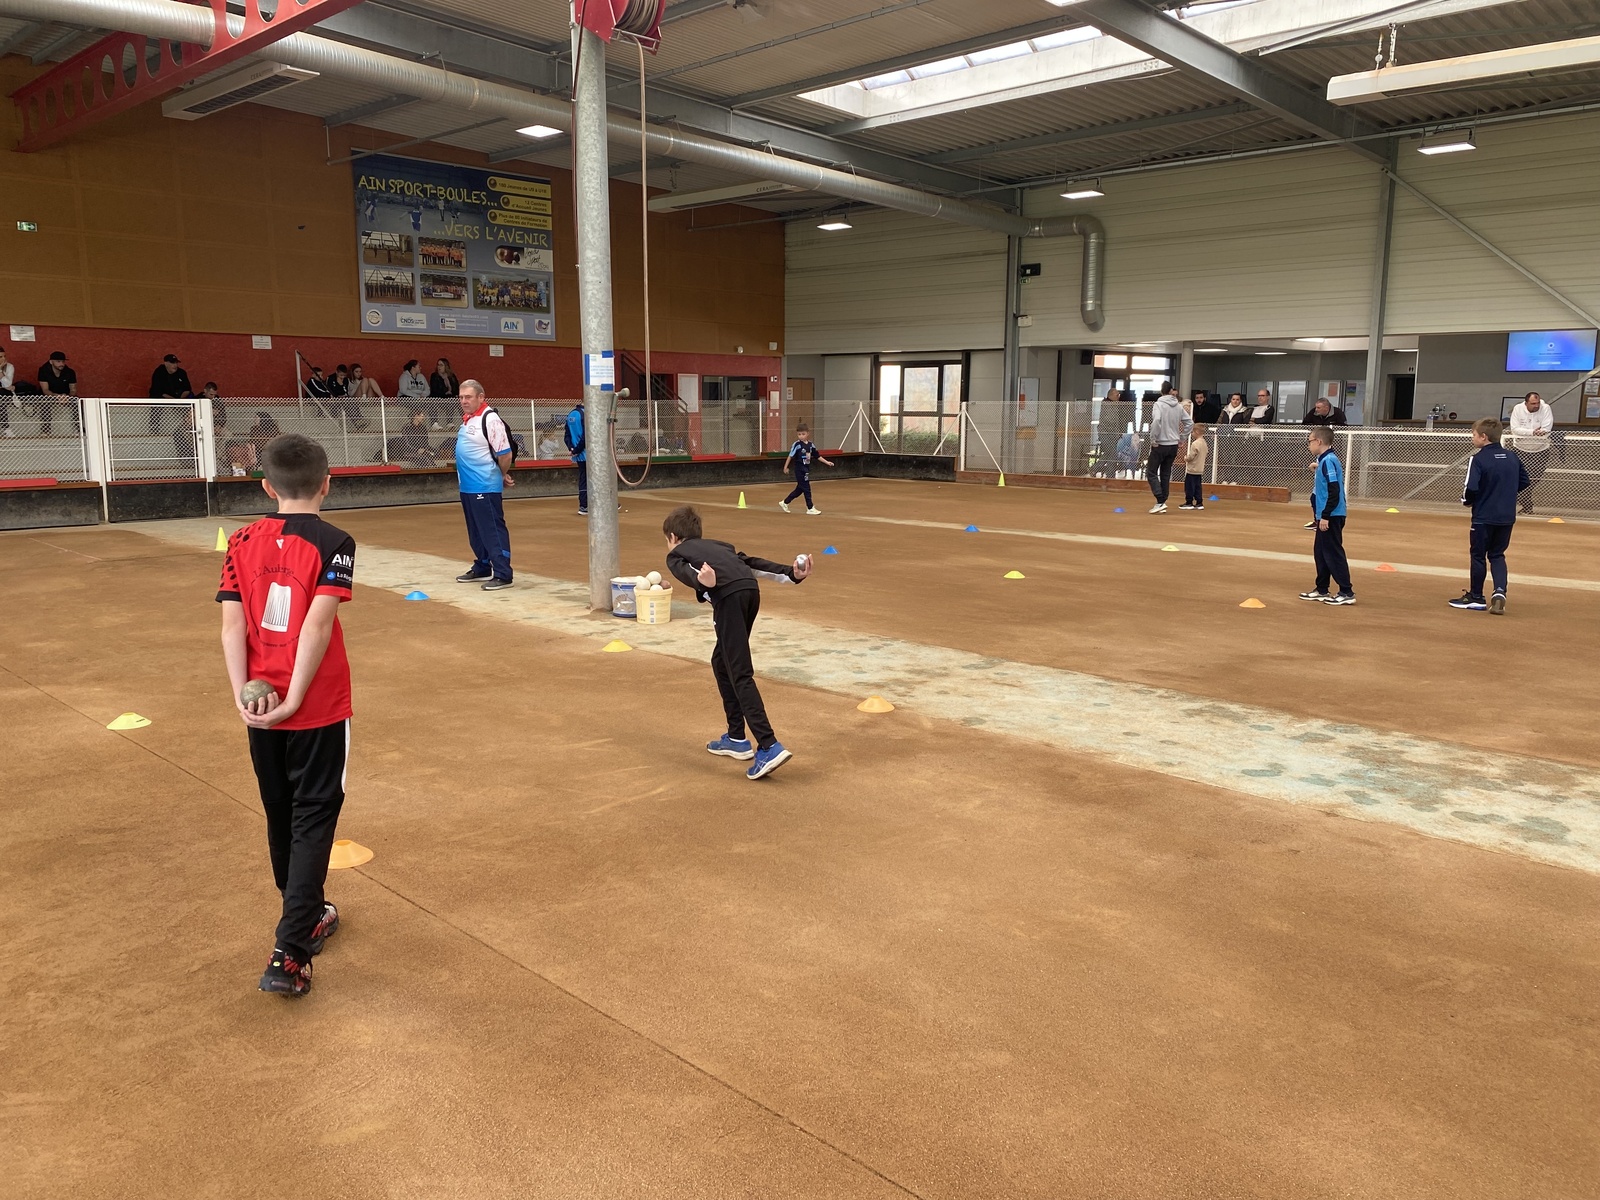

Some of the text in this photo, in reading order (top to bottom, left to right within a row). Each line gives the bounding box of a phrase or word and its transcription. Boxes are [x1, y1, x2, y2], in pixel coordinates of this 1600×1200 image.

[358, 175, 386, 191] AIN
[485, 226, 548, 248] L'AVENIR
[503, 321, 518, 330] AIN
[331, 553, 352, 567] AIN
